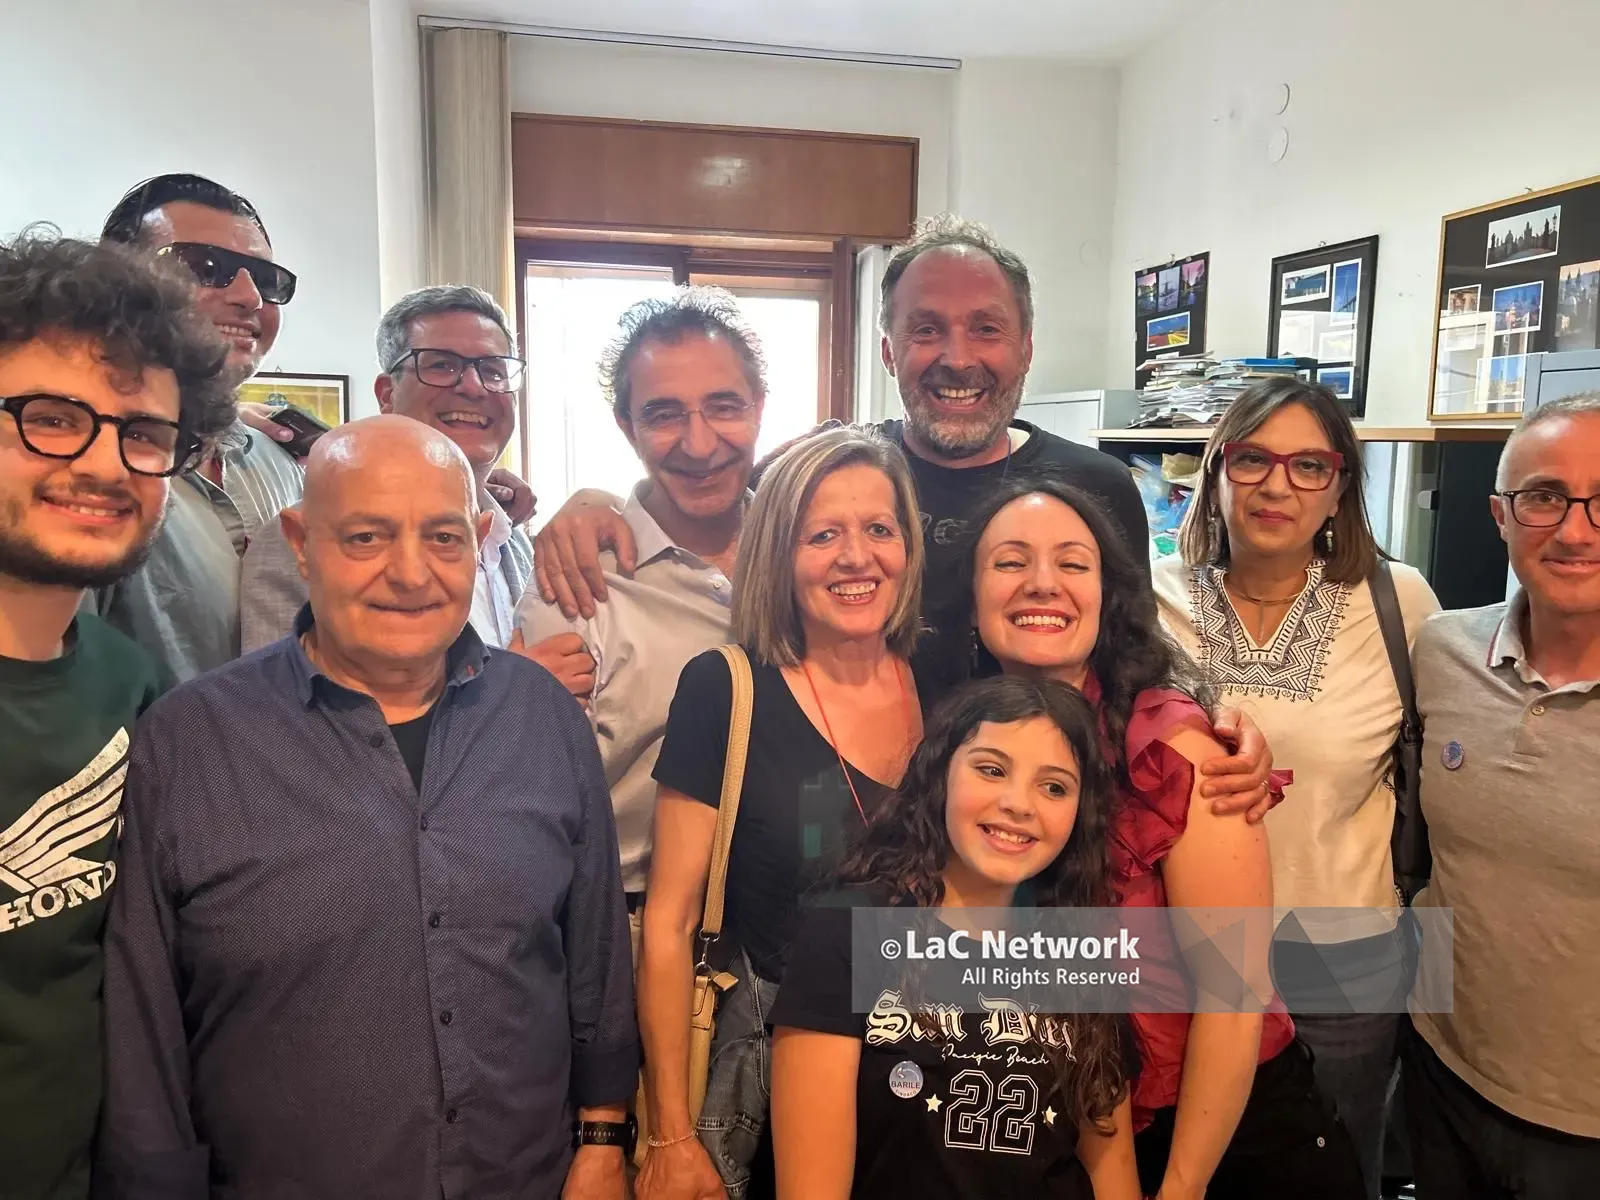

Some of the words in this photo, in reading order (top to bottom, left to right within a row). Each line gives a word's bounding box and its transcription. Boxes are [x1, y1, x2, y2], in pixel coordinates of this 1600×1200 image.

[0, 861, 117, 933] HOND
[942, 1043, 1002, 1066] Pacific
[1007, 1046, 1049, 1068] Beach
[891, 1081, 920, 1089] BARILE
[946, 1069, 1039, 1156] 22
